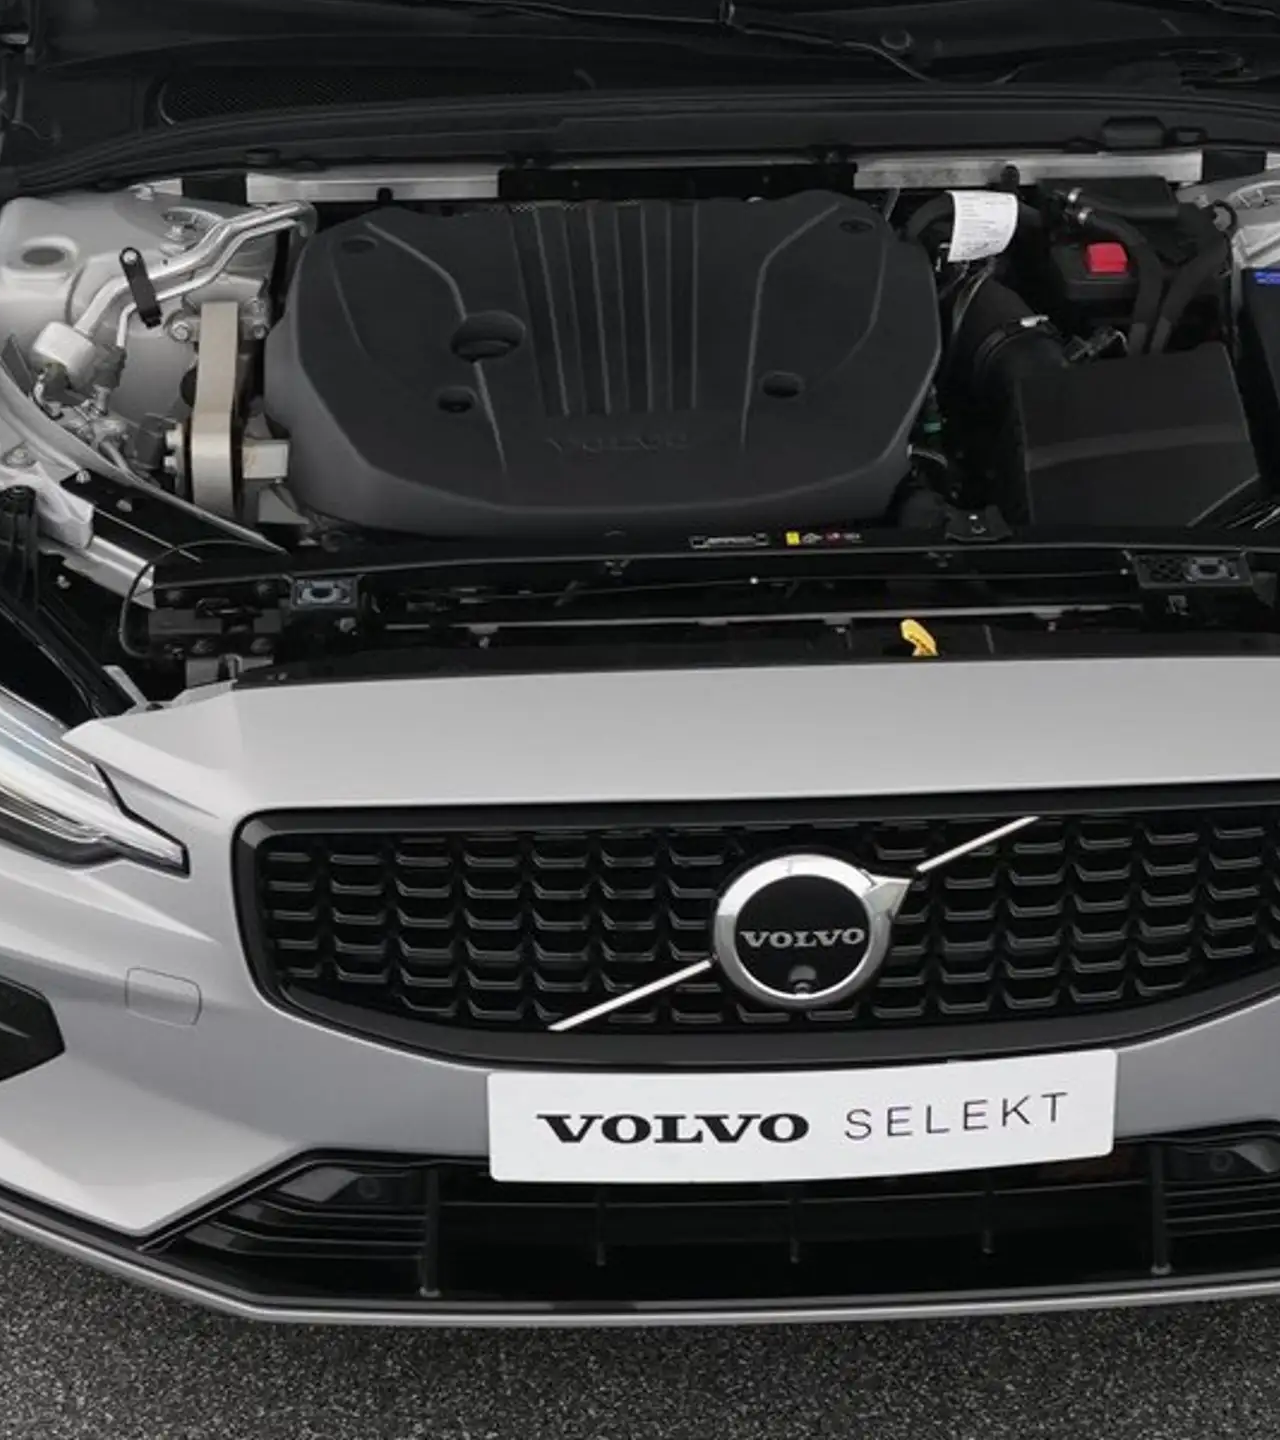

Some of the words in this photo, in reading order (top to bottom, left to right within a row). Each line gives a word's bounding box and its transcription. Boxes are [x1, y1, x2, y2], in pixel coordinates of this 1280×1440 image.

[739, 927, 865, 949] VOLVO
[536, 1112, 810, 1144] VOLVO
[843, 1091, 1069, 1141] SELEKT
